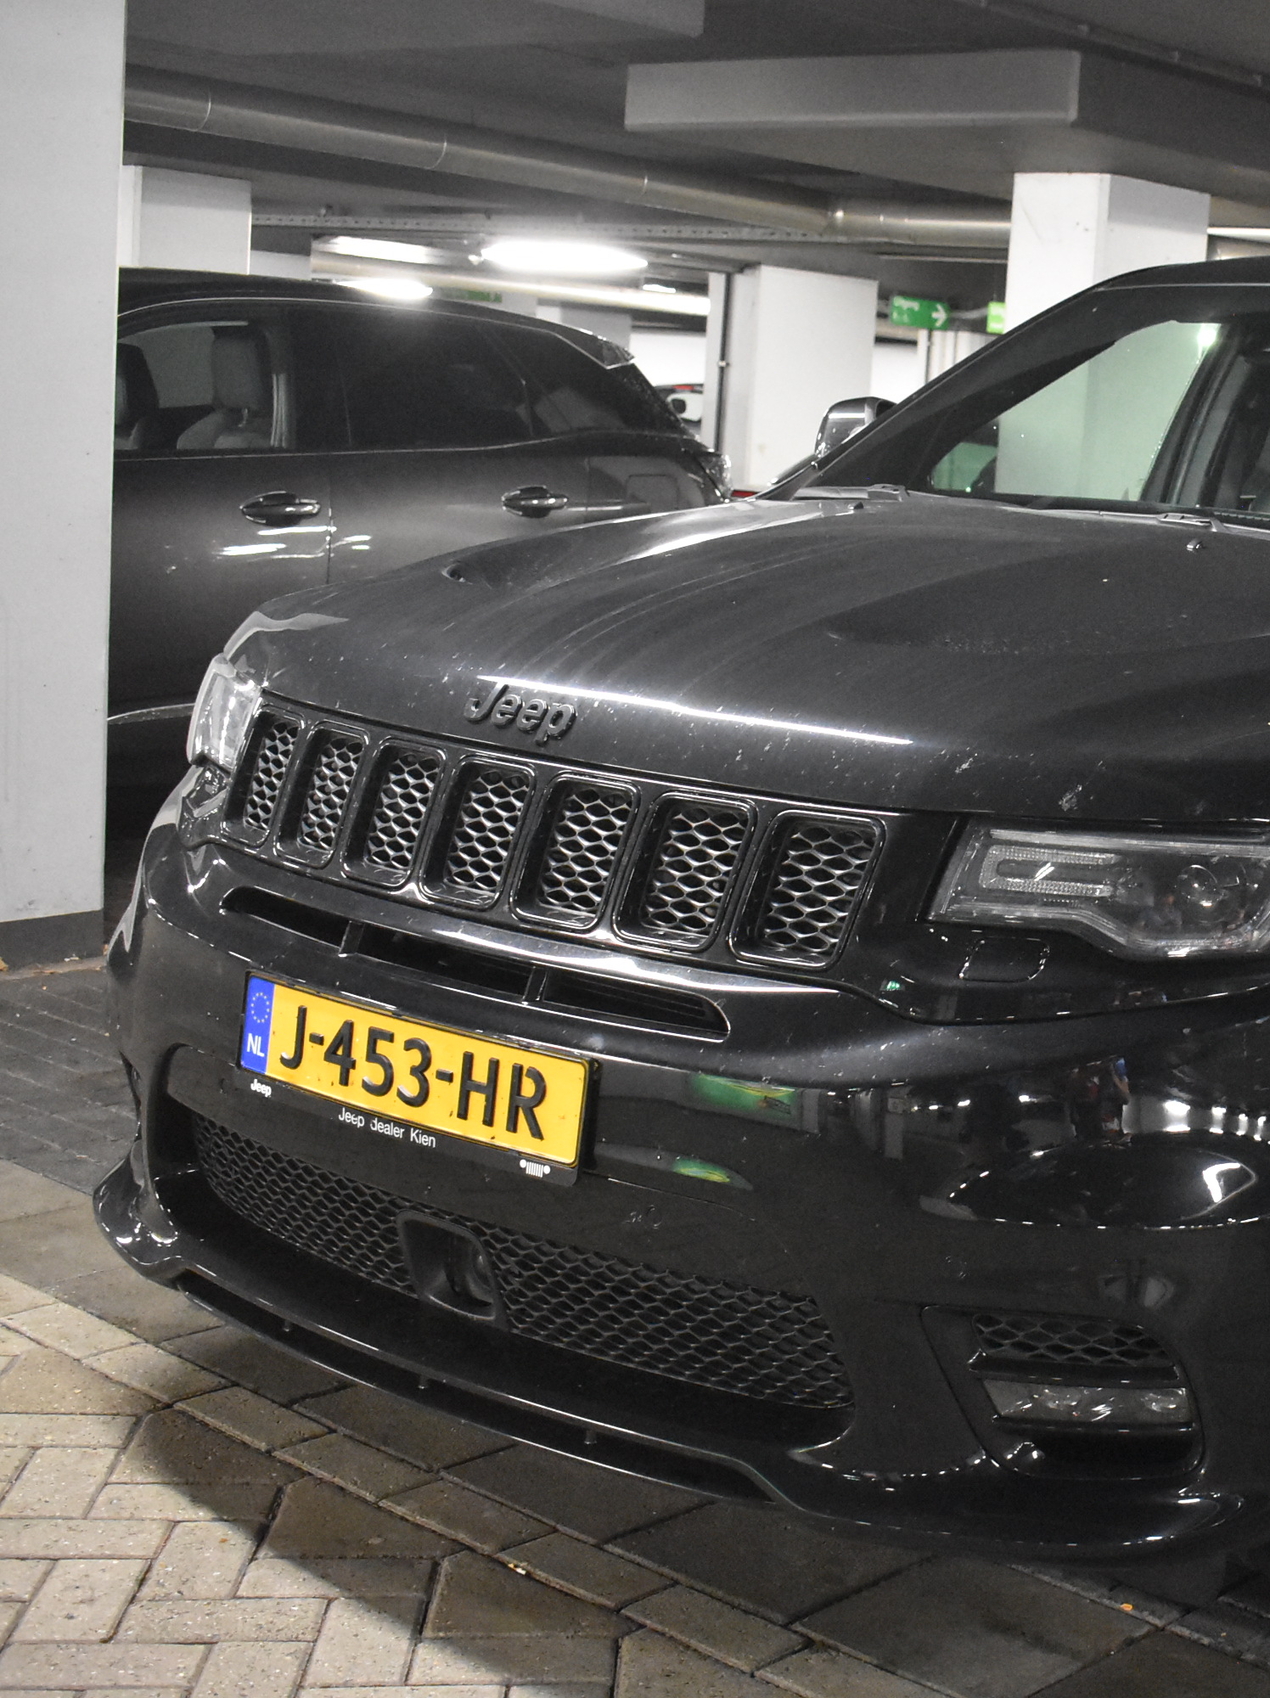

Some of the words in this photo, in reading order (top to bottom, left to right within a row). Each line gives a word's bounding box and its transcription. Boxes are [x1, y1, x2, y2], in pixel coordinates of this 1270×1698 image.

[463, 681, 578, 747] Jeep
[247, 1033, 265, 1058] NL
[251, 1079, 272, 1098] Jeep
[279, 1005, 546, 1141] J-453-HR
[338, 1107, 365, 1128] Jeep
[370, 1117, 405, 1139] dealer
[410, 1128, 436, 1148] Kien
